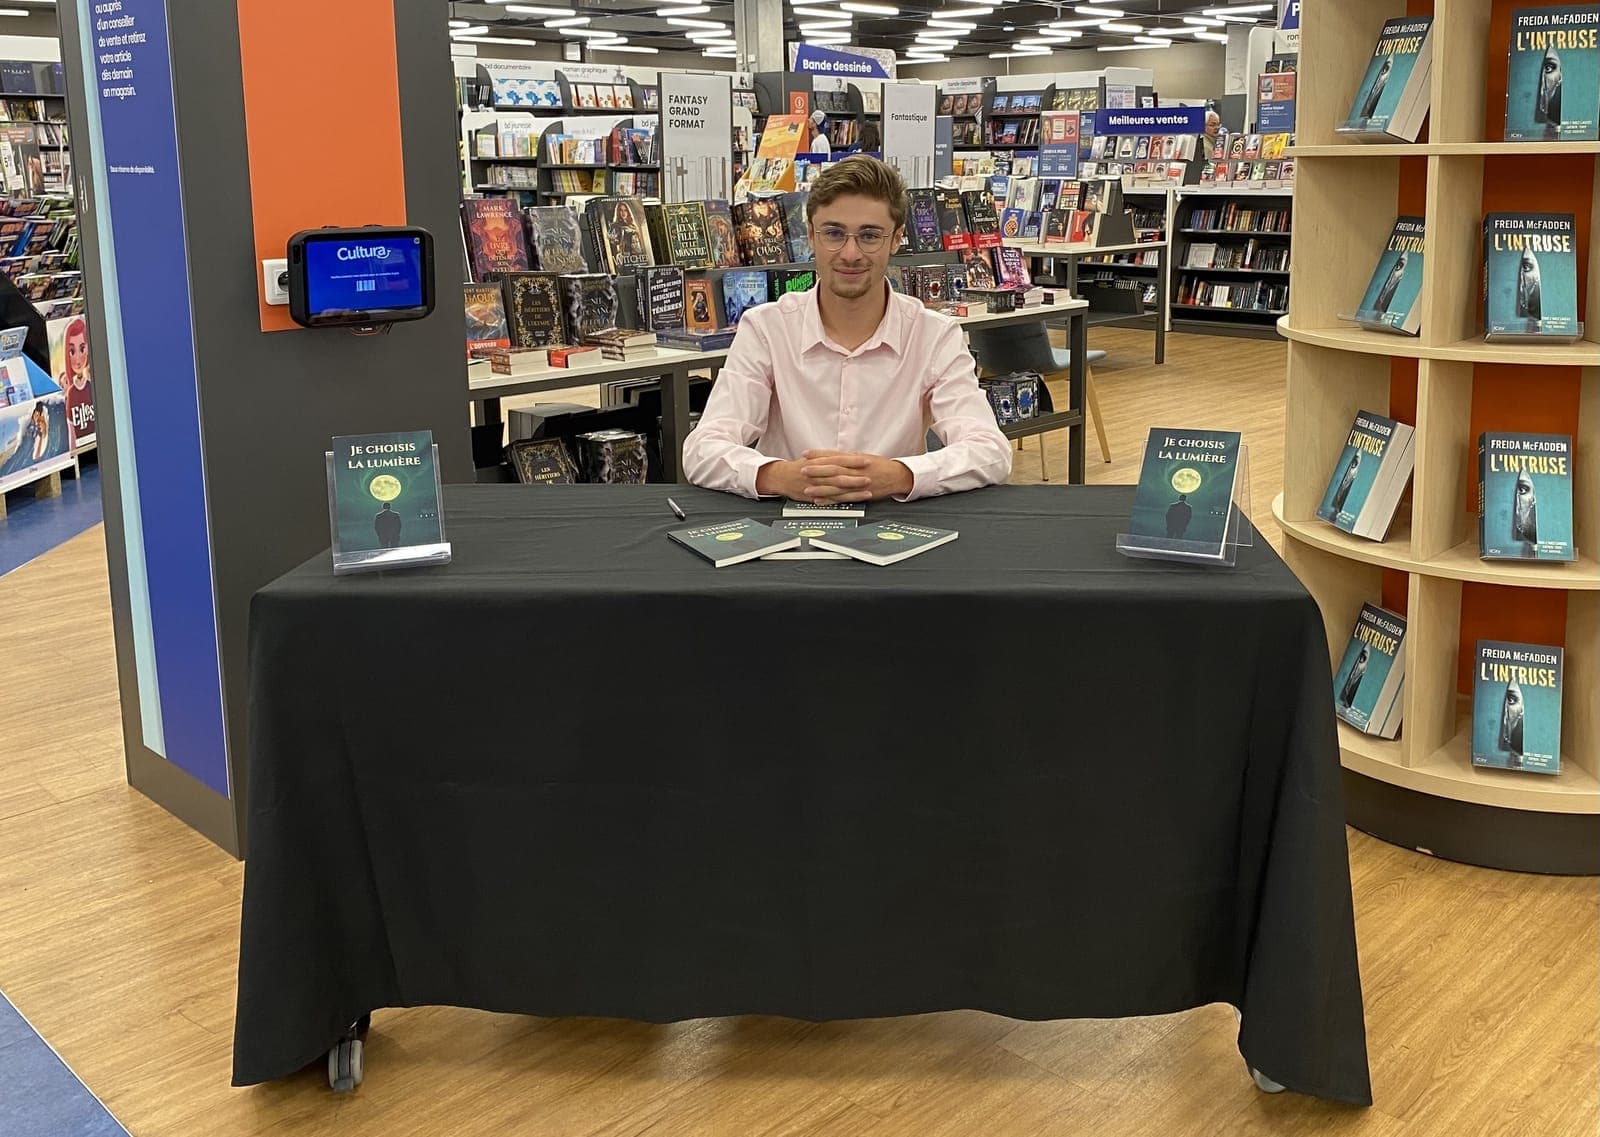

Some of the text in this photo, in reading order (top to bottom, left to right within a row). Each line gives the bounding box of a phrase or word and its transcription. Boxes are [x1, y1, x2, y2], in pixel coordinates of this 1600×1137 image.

[95, 0, 122, 15] ou auprès
[97, 14, 135, 31] d'un conseiller
[1518, 12, 1600, 27] FREIDA McFADDEN
[1382, 22, 1430, 36] FREIDA McFADDEN
[98, 31, 146, 48] de vente et retirez
[1374, 36, 1424, 57] L'INTRUSE
[1516, 28, 1598, 52] L'INTRUSE
[99, 50, 132, 64] votre article
[493, 63, 532, 72] documentaire
[802, 58, 872, 73] Bande dessinée
[101, 66, 134, 81] dès demain
[103, 83, 136, 100] en magasin.
[668, 94, 708, 105] FANTASY
[669, 106, 700, 116] GRAND
[891, 112, 928, 124] Fantastique
[669, 119, 705, 129] FORMAT
[1108, 115, 1189, 126] Meilleures ventes
[476, 211, 513, 219] LAWRENCE
[1395, 221, 1414, 233] FREIDA
[1494, 219, 1571, 231] FREIDA McFADDEN
[677, 231, 699, 242] FILLE
[1493, 233, 1571, 253] L'INTRUSE
[336, 245, 392, 261] Cultura
[673, 246, 708, 258] MONSTRE
[71, 403, 95, 430] Elles
[350, 442, 416, 457] JE CHOISIS
[1163, 436, 1225, 450] JE CHOISIS
[1347, 428, 1386, 458] L'INTRUSE
[1490, 439, 1567, 453] FREIDA McFADDEN
[347, 455, 422, 470] LA LUMIÈRE
[1158, 450, 1227, 464] LA LUMIÈRE
[1490, 453, 1567, 476] L'INTRUSE
[1360, 609, 1404, 637] FREIDA McFADDEN
[1353, 621, 1399, 657] L'INTRUSE
[1481, 647, 1557, 665] FREIDA McFADDEN
[1480, 661, 1557, 688] L'INTRUSE
